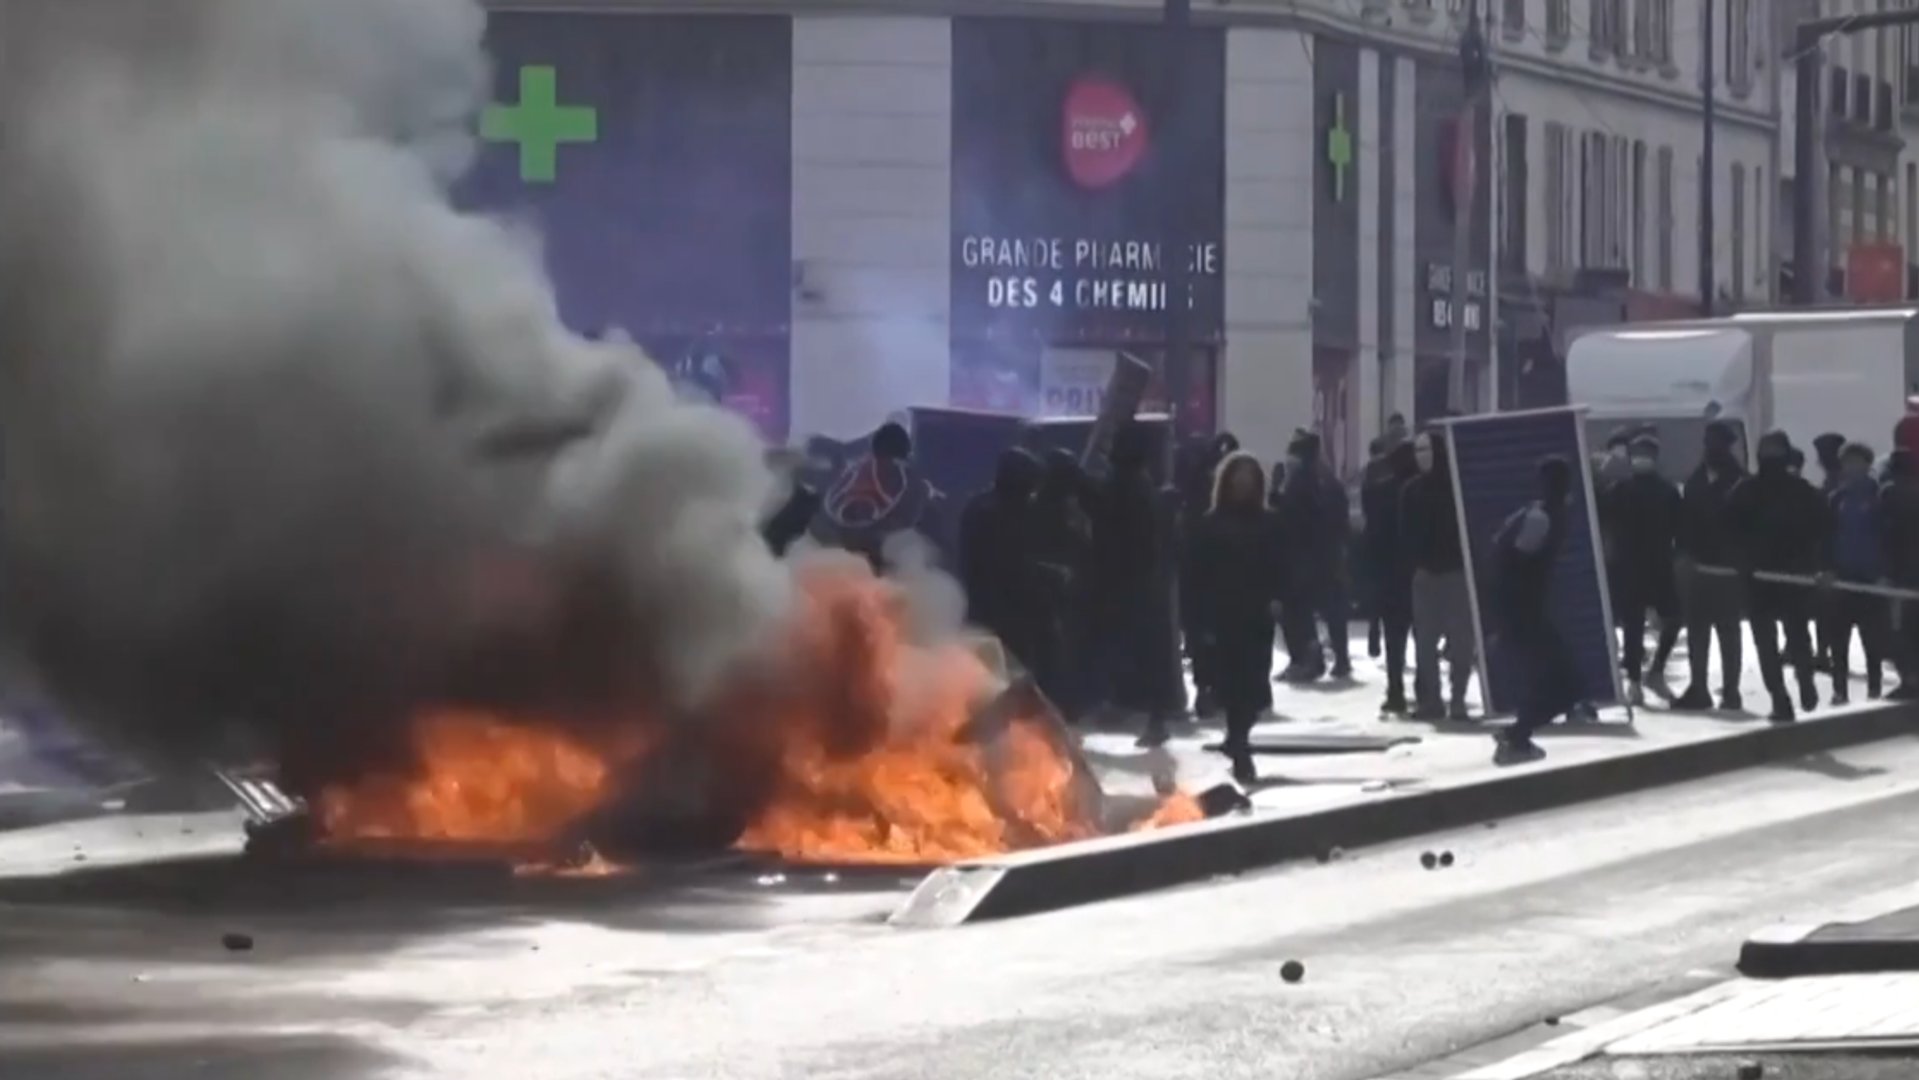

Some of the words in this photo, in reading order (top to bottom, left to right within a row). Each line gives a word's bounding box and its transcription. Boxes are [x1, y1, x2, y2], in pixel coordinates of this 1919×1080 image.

[962, 235, 1063, 270] GRANDE
[1075, 239, 1217, 274] PHARMIE
[987, 277, 1038, 308] DES
[1049, 278, 1064, 307] 4
[1075, 280, 1194, 311] CHEMI
